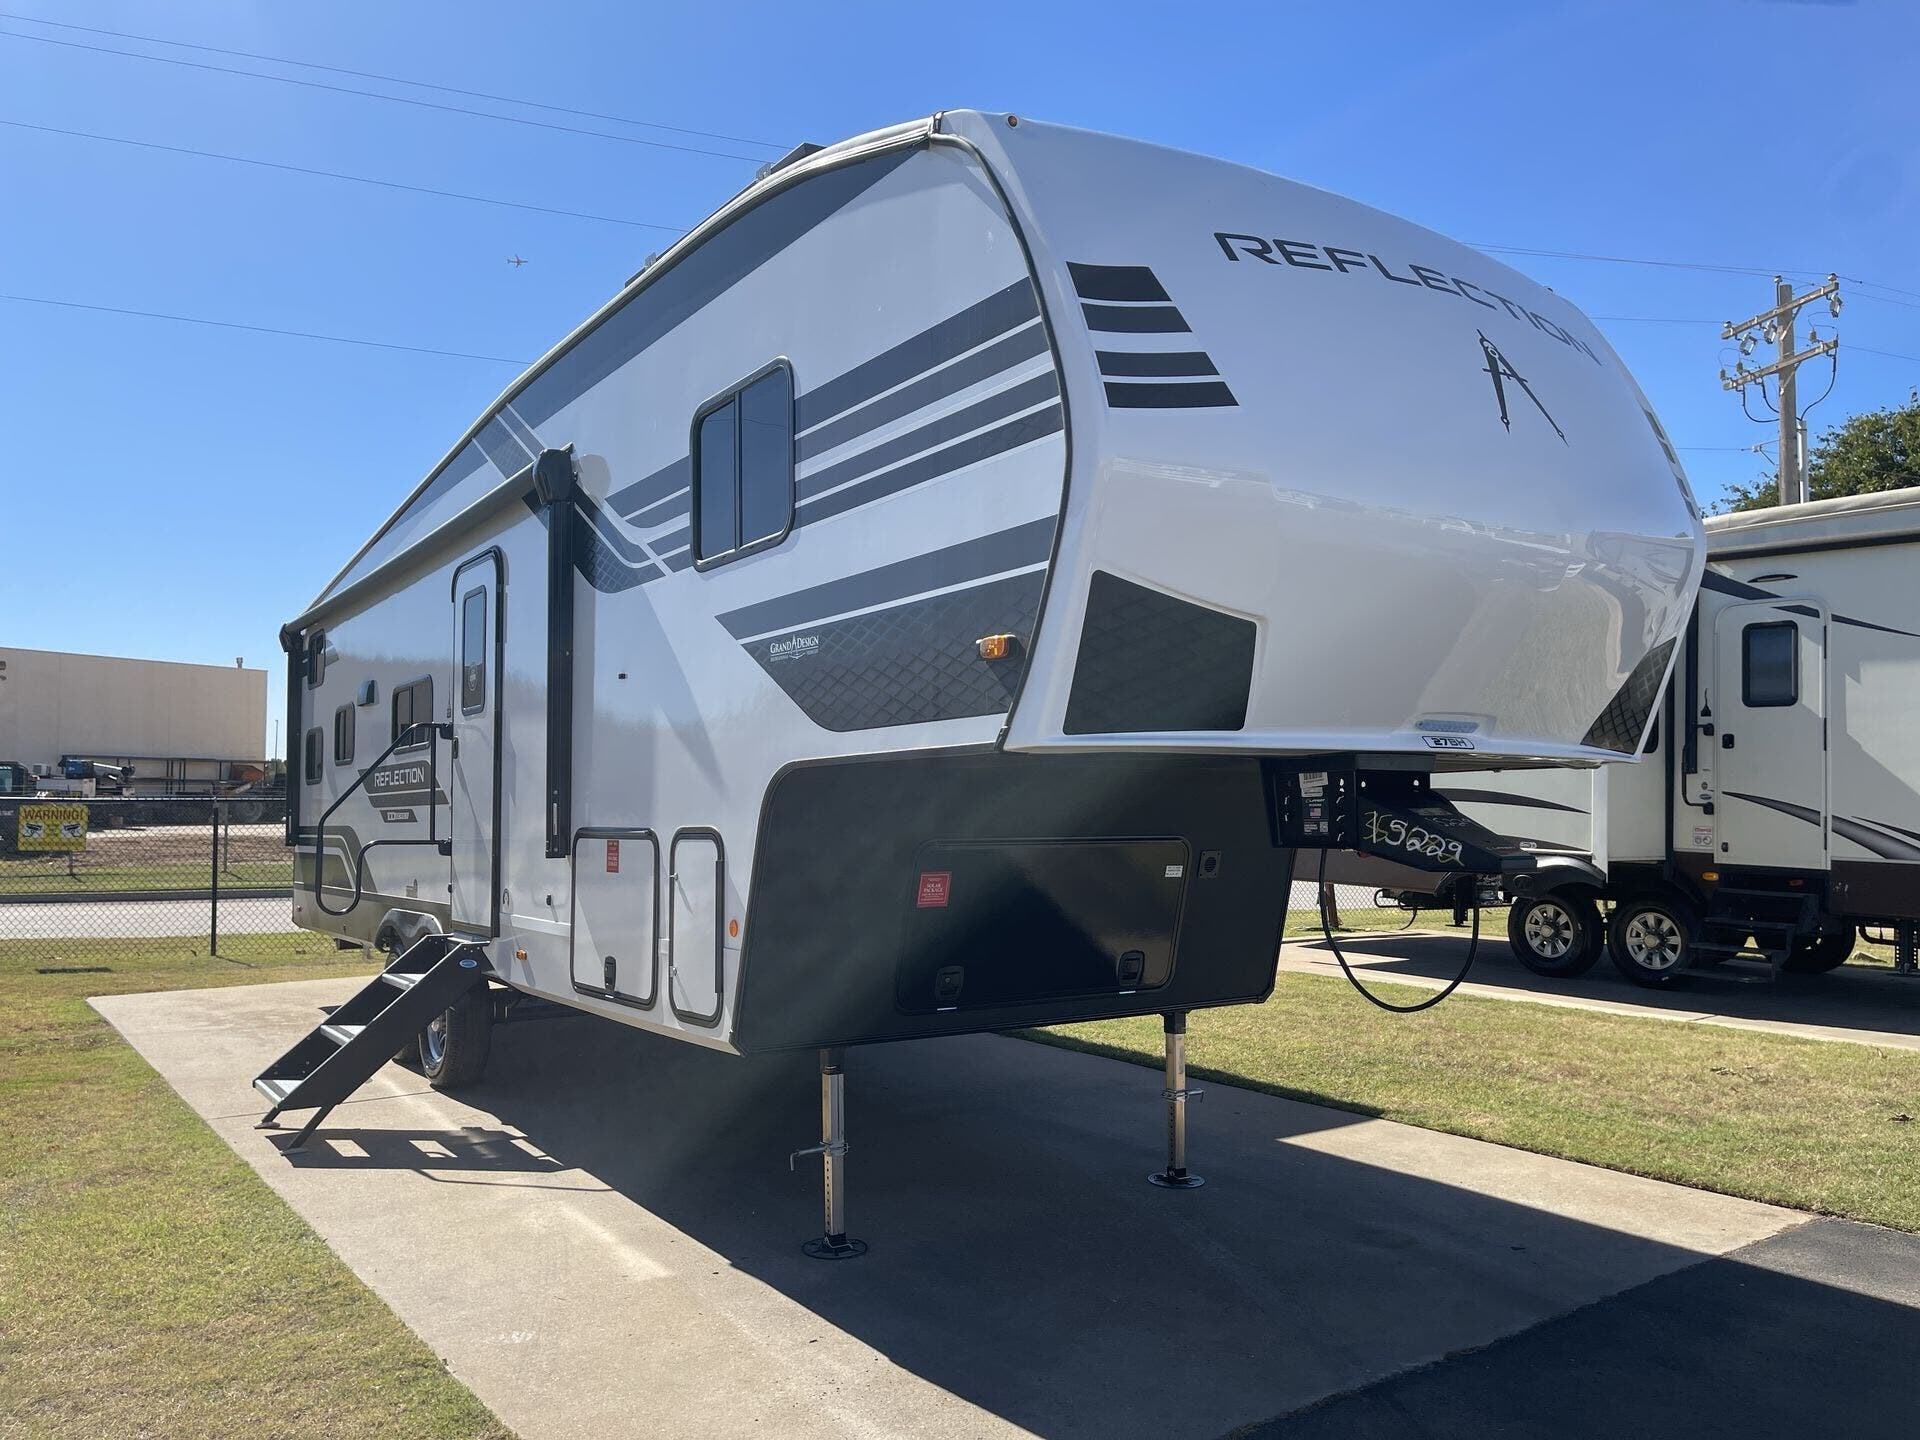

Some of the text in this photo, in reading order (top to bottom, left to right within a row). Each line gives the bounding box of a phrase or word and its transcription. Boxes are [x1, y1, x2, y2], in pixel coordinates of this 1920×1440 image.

[1214, 232, 1602, 366] REFLECTION
[770, 641, 792, 654] GRAND
[797, 635, 819, 649] DESIGN
[374, 766, 425, 788] REFLECTION
[24, 809, 84, 820] WARNING!
